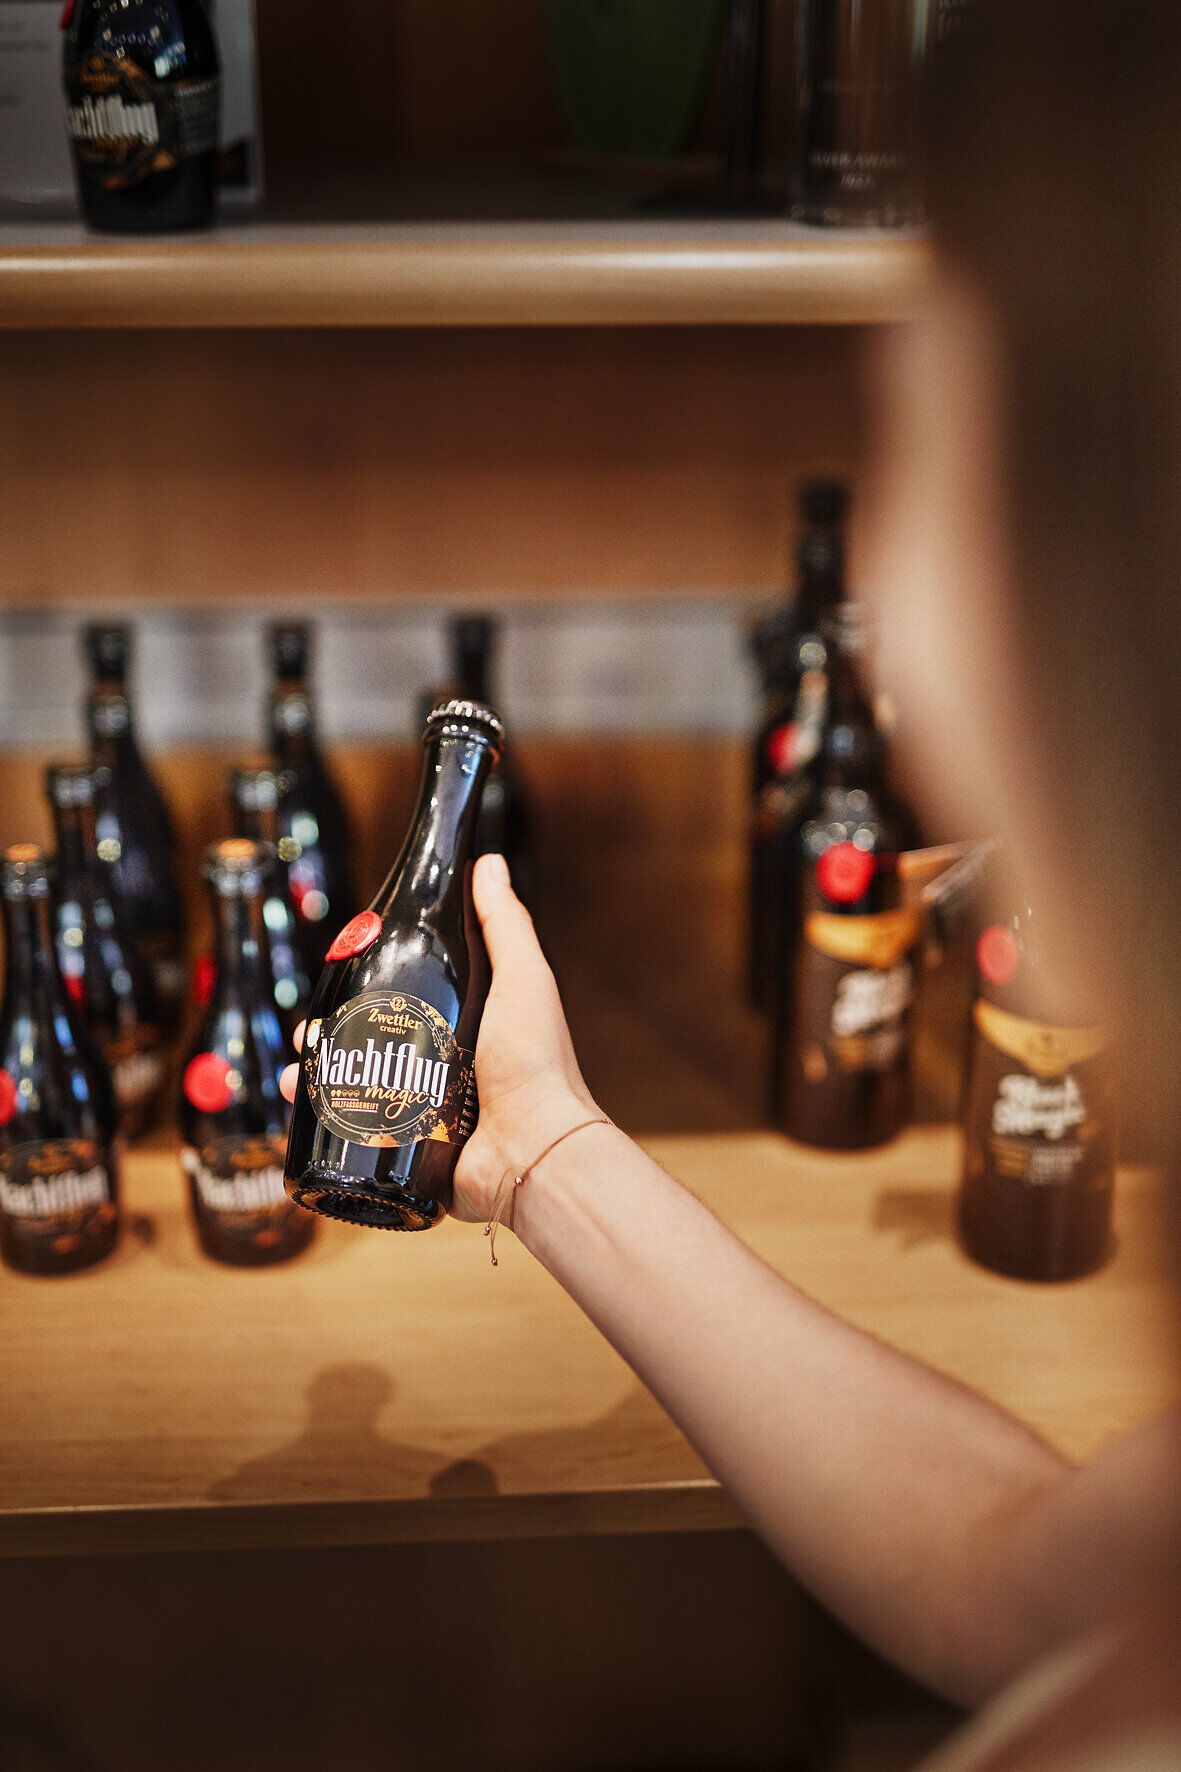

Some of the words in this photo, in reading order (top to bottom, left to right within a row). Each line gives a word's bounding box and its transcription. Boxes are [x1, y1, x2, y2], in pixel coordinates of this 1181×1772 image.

[368, 1008, 422, 1031] Zwettler
[380, 1025, 406, 1036] creativ
[315, 1038, 450, 1107] Nachtflug
[331, 1101, 379, 1110] HOLZFASSGEREIFT
[364, 1084, 429, 1120] magic
